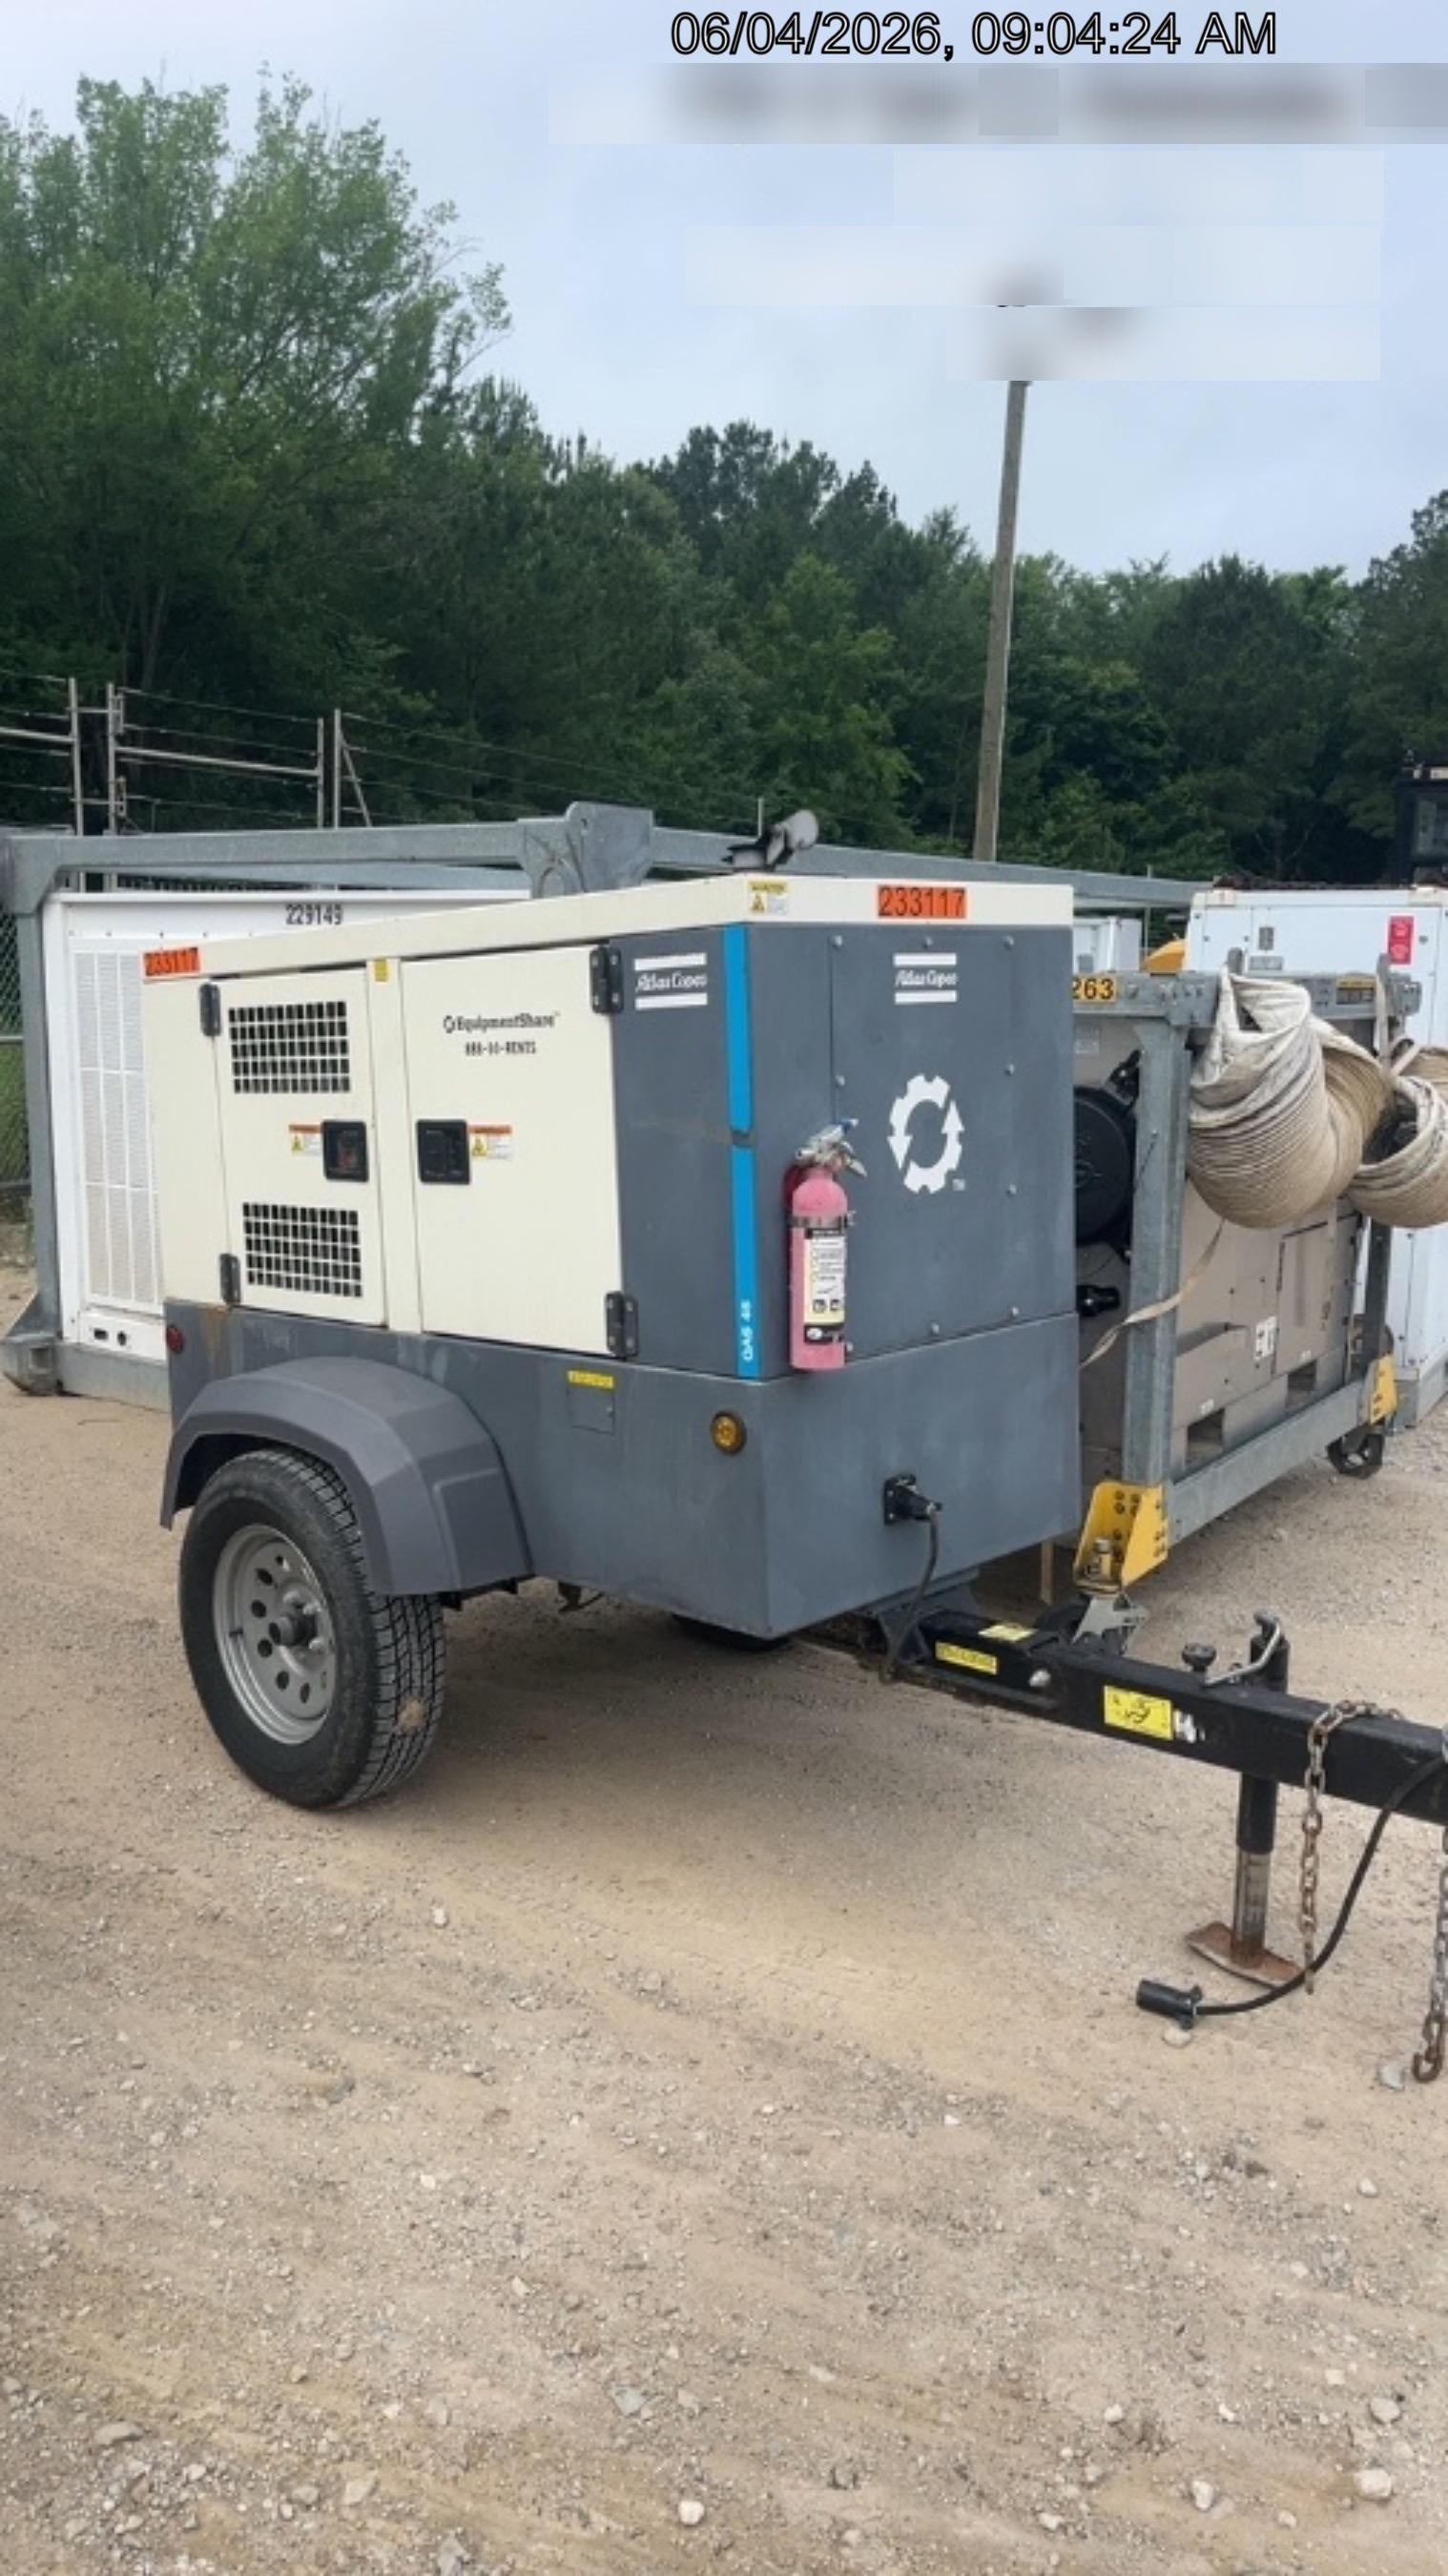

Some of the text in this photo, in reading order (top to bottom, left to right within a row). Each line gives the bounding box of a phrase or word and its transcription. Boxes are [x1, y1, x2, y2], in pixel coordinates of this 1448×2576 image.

[879, 885, 965, 917] 233117
[286, 904, 343, 925] 229149
[635, 972, 671, 992] Atlas
[896, 968, 925, 987] Atlas
